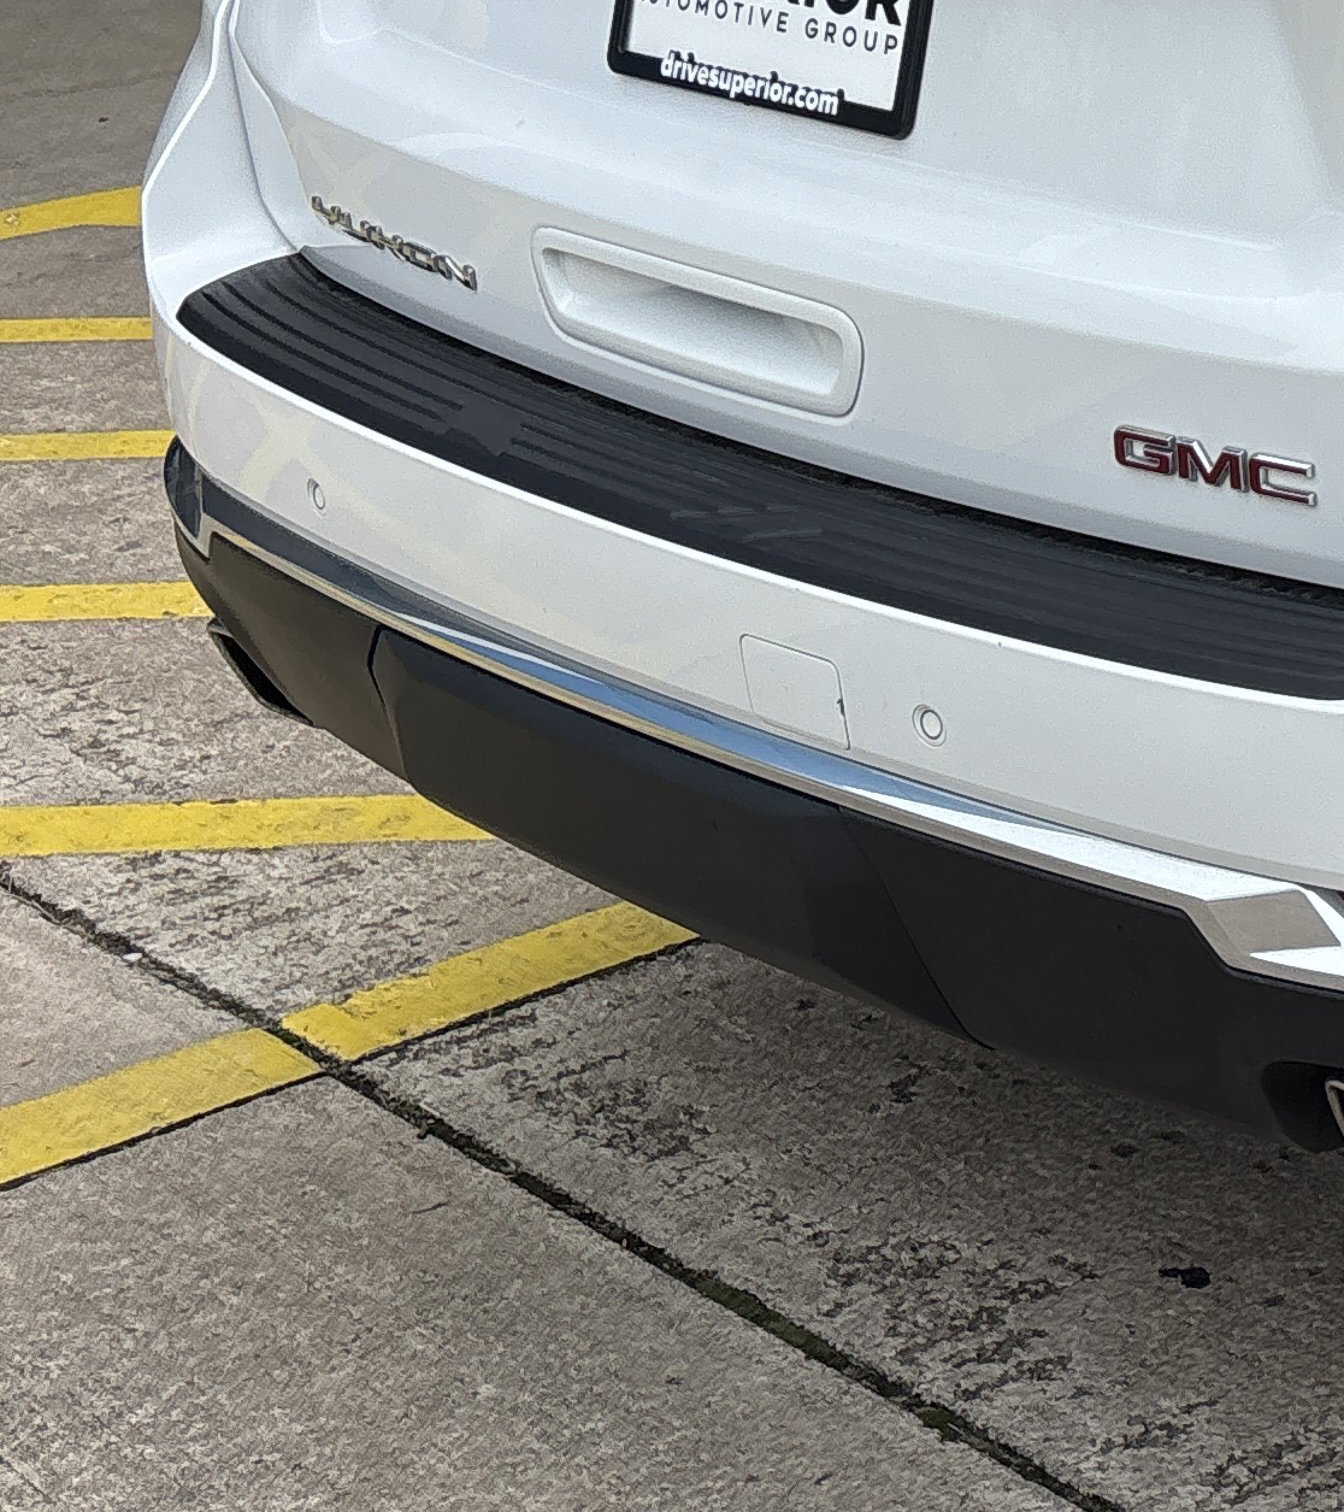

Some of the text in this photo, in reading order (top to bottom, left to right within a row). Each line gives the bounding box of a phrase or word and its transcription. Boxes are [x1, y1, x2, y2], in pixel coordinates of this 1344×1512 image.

[804, 16, 898, 55] GROUP
[660, 51, 840, 116] drivesuperior.com
[1112, 424, 1318, 507] GMC
